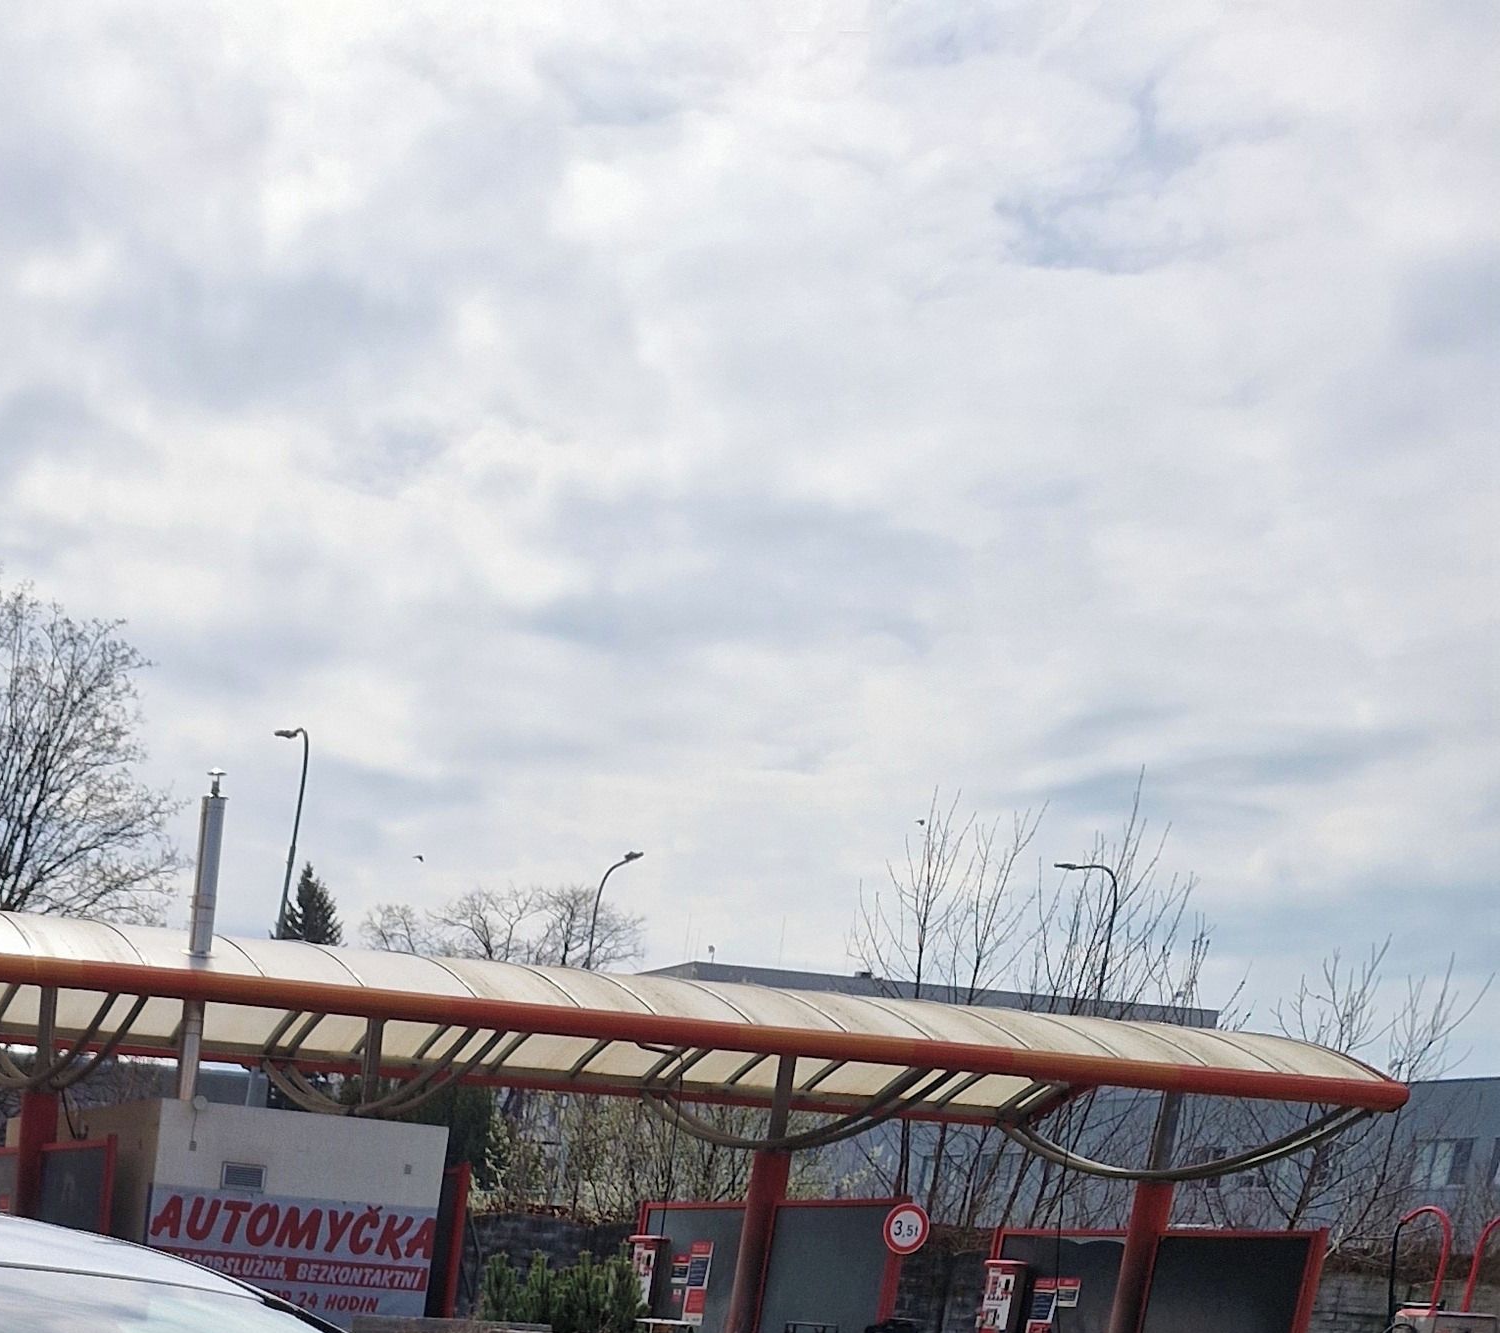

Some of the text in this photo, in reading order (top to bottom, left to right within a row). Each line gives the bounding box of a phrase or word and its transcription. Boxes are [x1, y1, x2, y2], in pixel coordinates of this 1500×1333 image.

[150, 1194, 437, 1261] AUTOMYČKA
[182, 1253, 423, 1289] OBSLUŽNÁ, BEZKONTAKTNÍ
[297, 1291, 318, 1310] 24
[324, 1294, 379, 1313] HODIN
